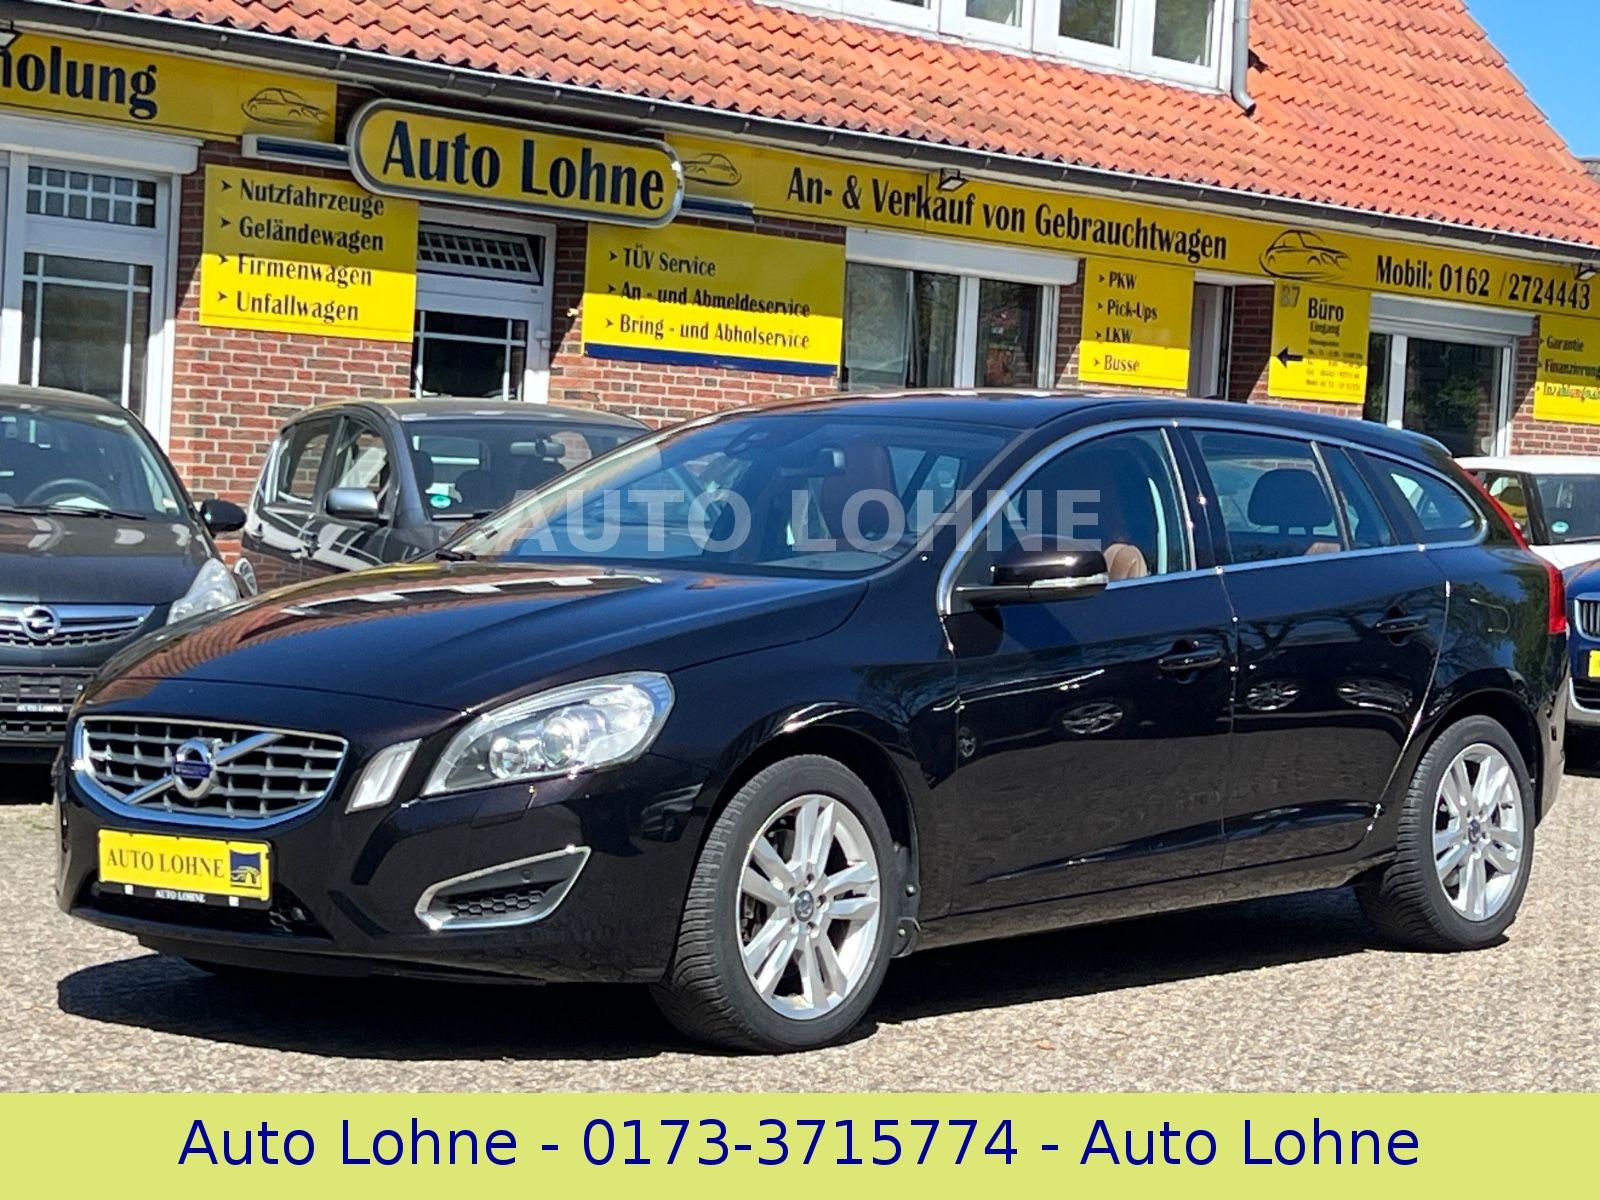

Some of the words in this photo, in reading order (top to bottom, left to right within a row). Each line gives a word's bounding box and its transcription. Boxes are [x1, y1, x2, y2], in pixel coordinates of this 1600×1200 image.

[383, 120, 500, 188] Auto
[521, 139, 664, 210] Lohne
[240, 178, 384, 219] Nutzfahrzeuge
[787, 167, 832, 204] An-
[842, 175, 862, 210] &
[872, 178, 976, 225] Verkauf
[983, 203, 1025, 232] von
[1035, 203, 1227, 263] Gebrauchtwagen
[239, 216, 383, 253] Geländewagen
[238, 253, 372, 288] Firmenwagen
[624, 244, 654, 269] TÜV
[660, 252, 716, 277] Service
[1376, 255, 1433, 290] Mobil:
[1439, 263, 1490, 297] 0162
[1109, 271, 1137, 289] PKW
[236, 291, 358, 323] Unfallwagen
[621, 281, 641, 300] An
[657, 286, 687, 305] und
[693, 289, 810, 317] Abmeldeservice
[1107, 299, 1158, 322] Pick-Ups
[1308, 297, 1344, 321] Büro
[620, 314, 664, 340] Bring
[680, 323, 709, 340] und
[714, 323, 809, 349] Abholservice
[1105, 327, 1132, 343] LKW
[1547, 335, 1584, 351] Garantie
[1104, 354, 1139, 372] Busse
[107, 849, 154, 871] AUTO
[160, 854, 225, 878] LOHNE
